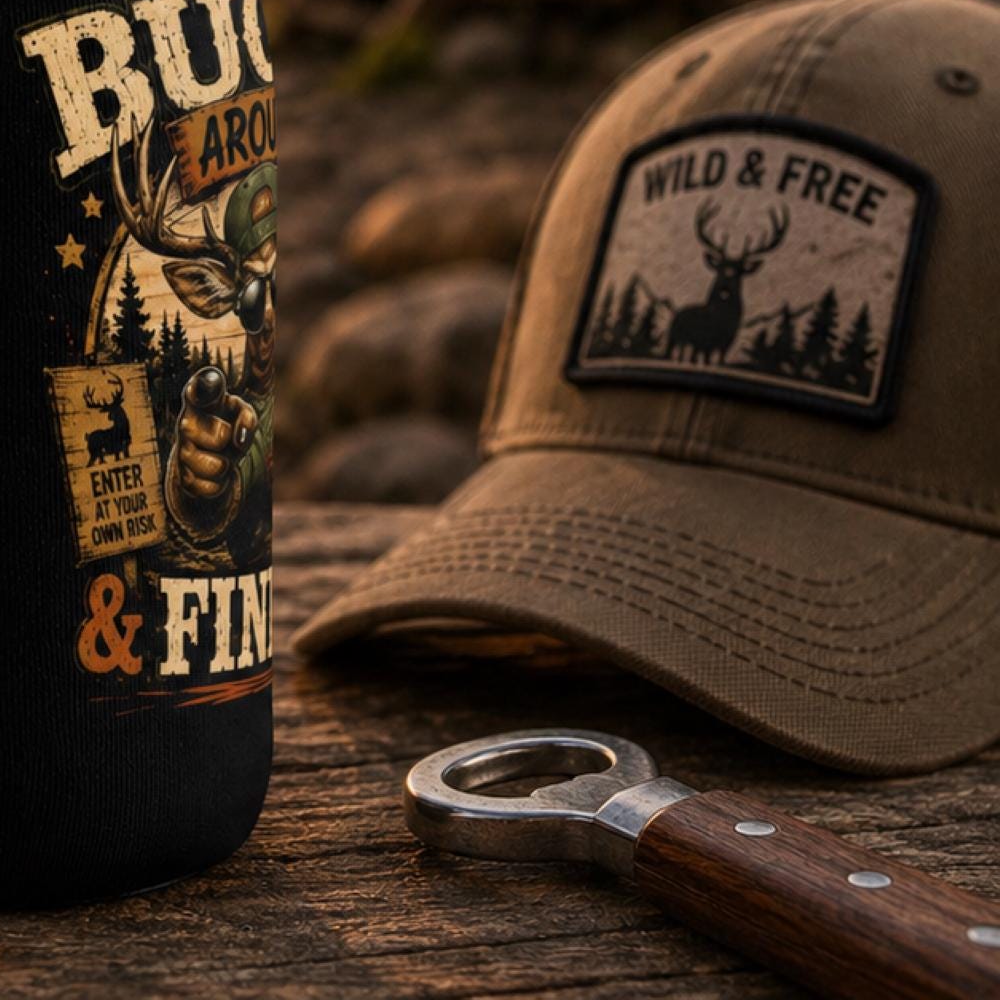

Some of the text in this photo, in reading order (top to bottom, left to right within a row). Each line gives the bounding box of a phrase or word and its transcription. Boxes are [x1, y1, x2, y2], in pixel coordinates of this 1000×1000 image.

[643, 148, 888, 226] WILD & FREE
[90, 463, 144, 498] ENTER
[95, 491, 148, 522] AT YOUR
[91, 513, 157, 546] OWN RISK
[77, 573, 144, 676] &
